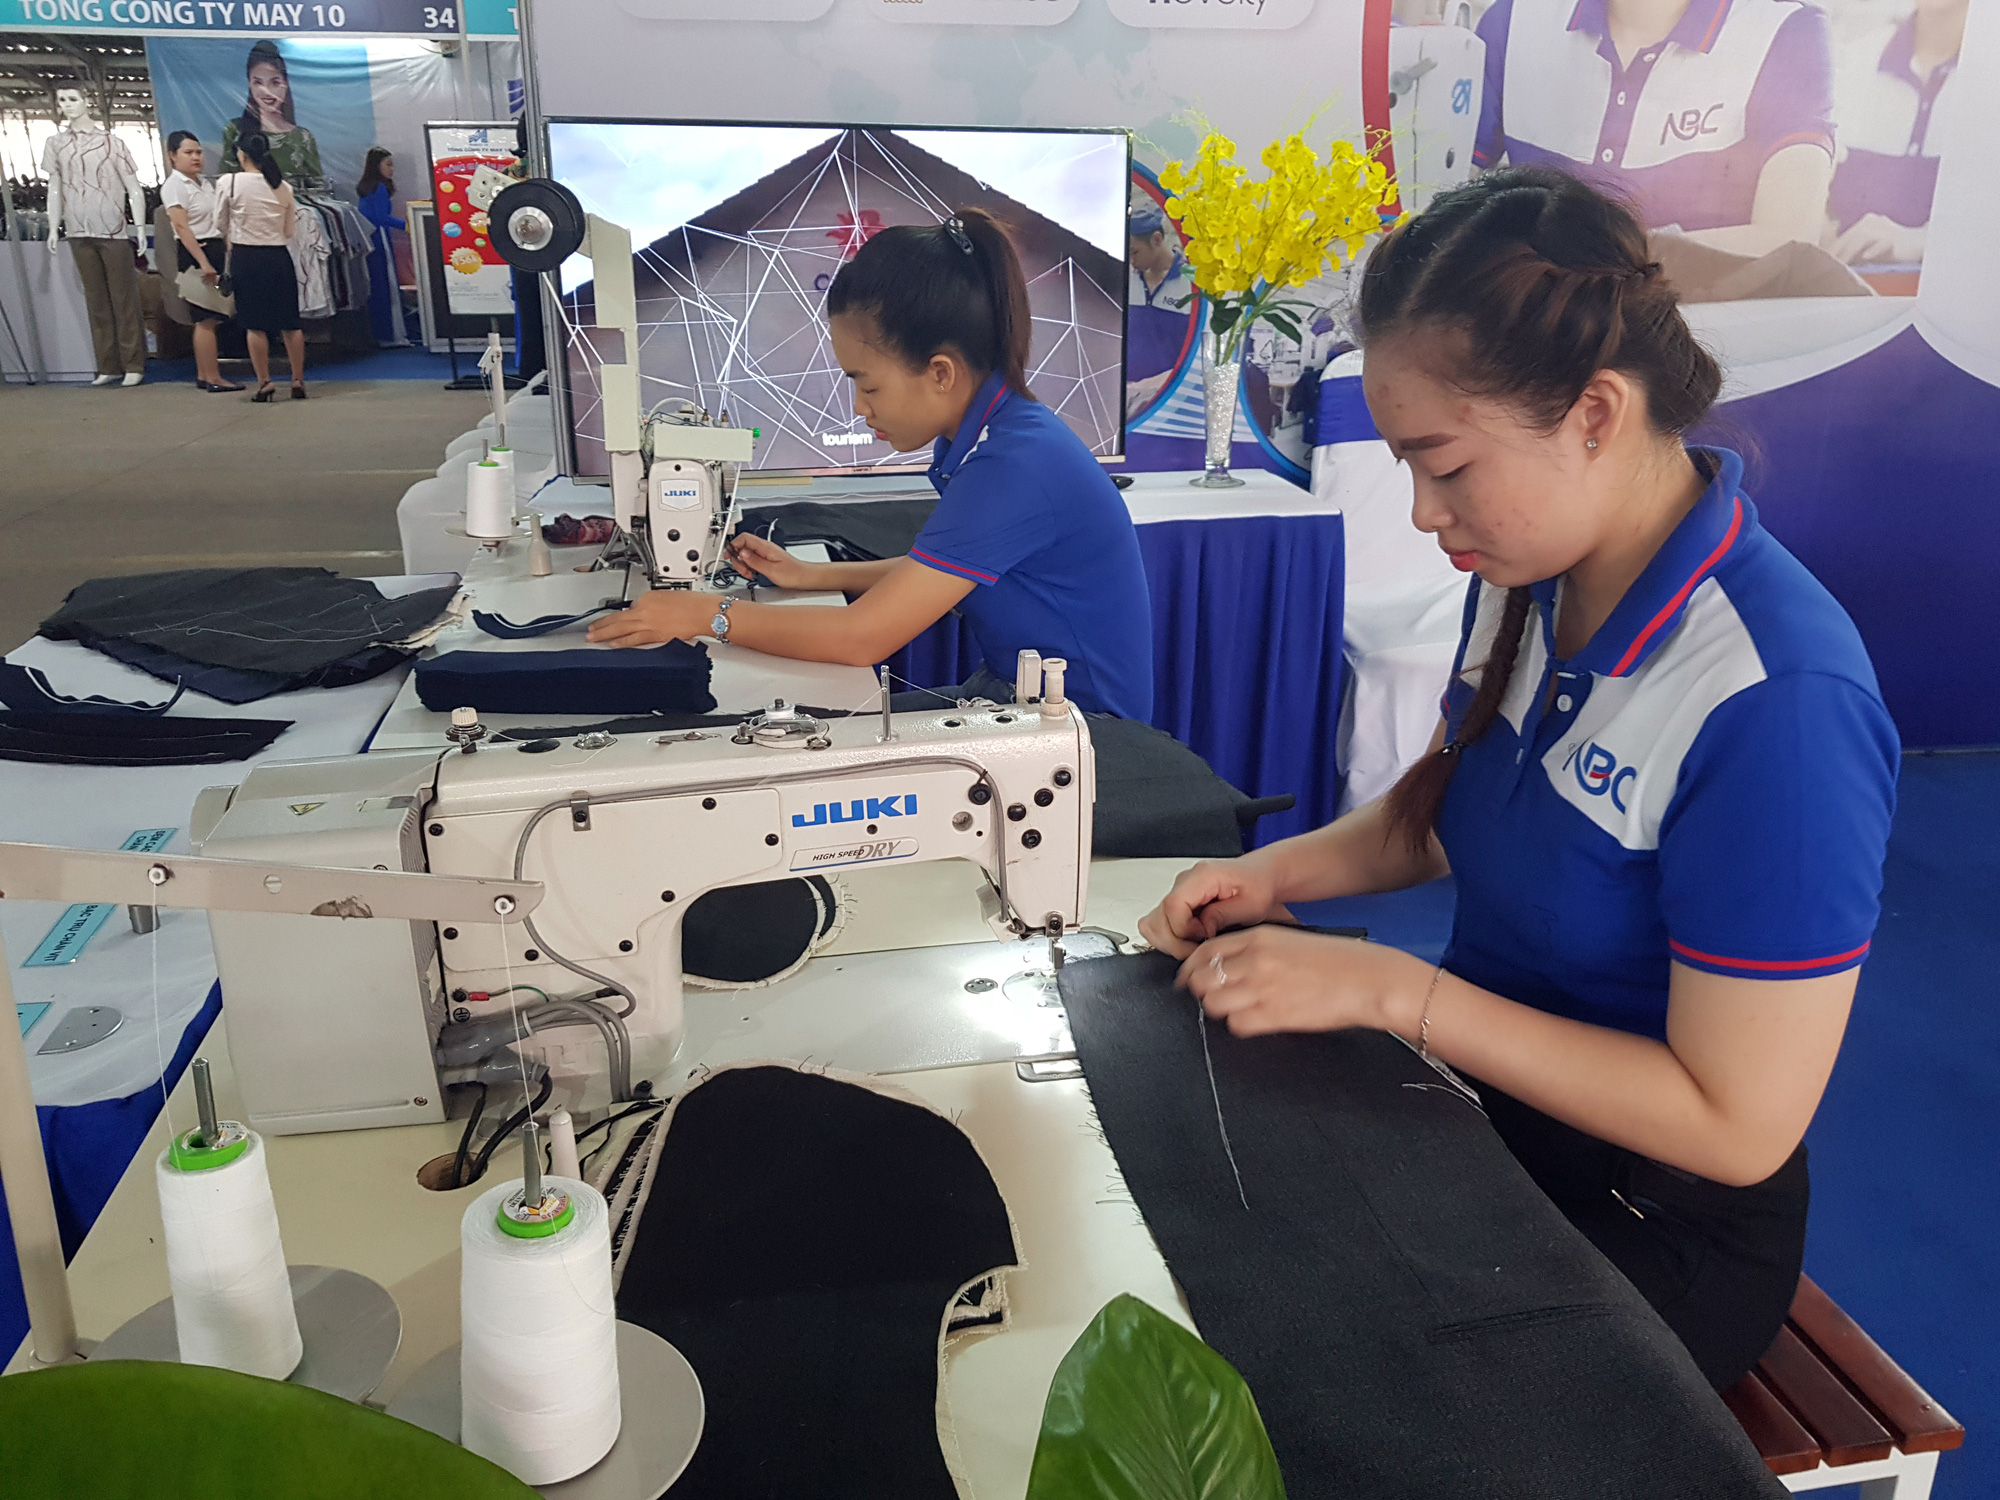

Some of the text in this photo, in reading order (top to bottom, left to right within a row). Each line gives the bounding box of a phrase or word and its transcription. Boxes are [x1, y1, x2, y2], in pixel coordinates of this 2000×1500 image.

[198, 2, 236, 25] TY
[243, 3, 303, 27] MAY
[312, 5, 345, 27] 10
[424, 7, 455, 28] 34
[822, 432, 873, 446] tourism
[792, 794, 918, 828] JUKI
[812, 840, 902, 861] HIGH SPEED DRY
